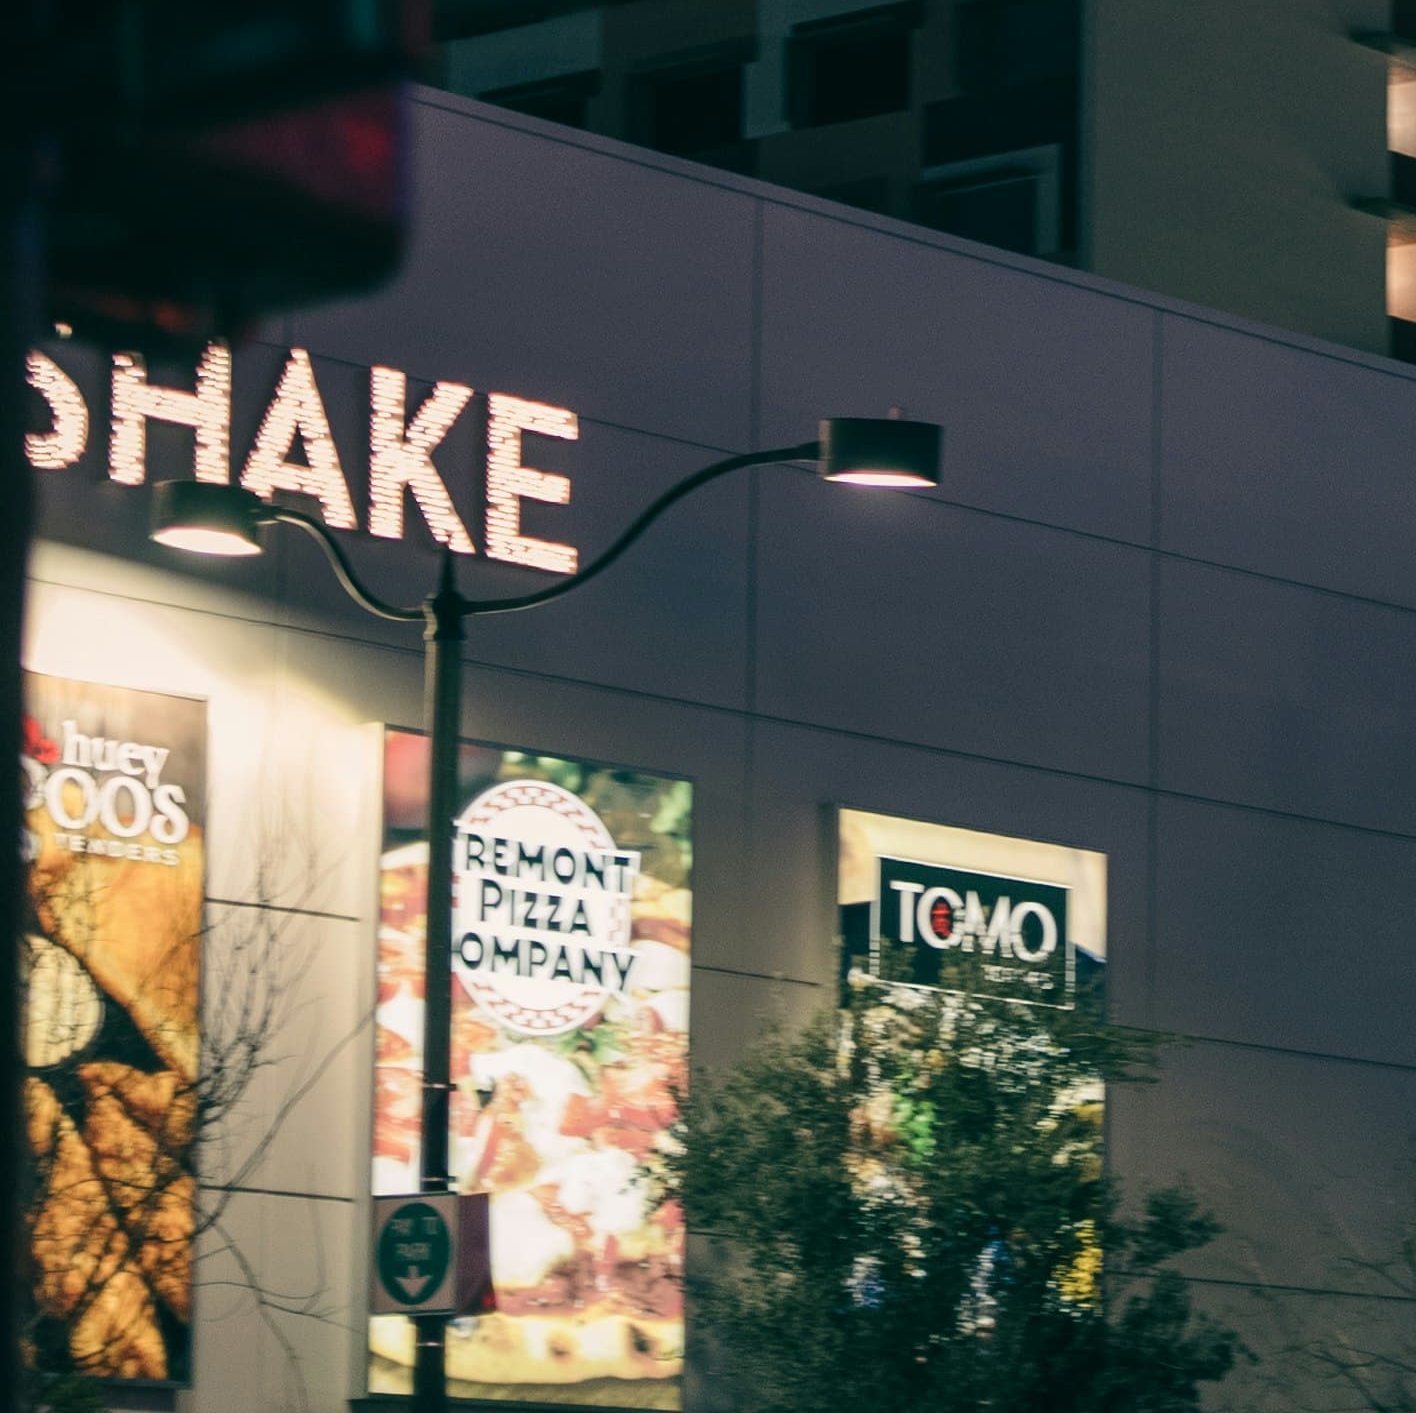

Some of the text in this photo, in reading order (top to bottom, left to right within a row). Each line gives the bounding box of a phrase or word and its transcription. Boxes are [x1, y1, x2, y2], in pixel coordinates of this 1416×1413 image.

[61, 720, 170, 790] huey
[54, 832, 182, 866] TENDERS
[464, 831, 632, 894] REMONT
[480, 877, 592, 937] PIZZA
[889, 879, 1058, 963] TOMO
[452, 931, 637, 993] OMPANY
